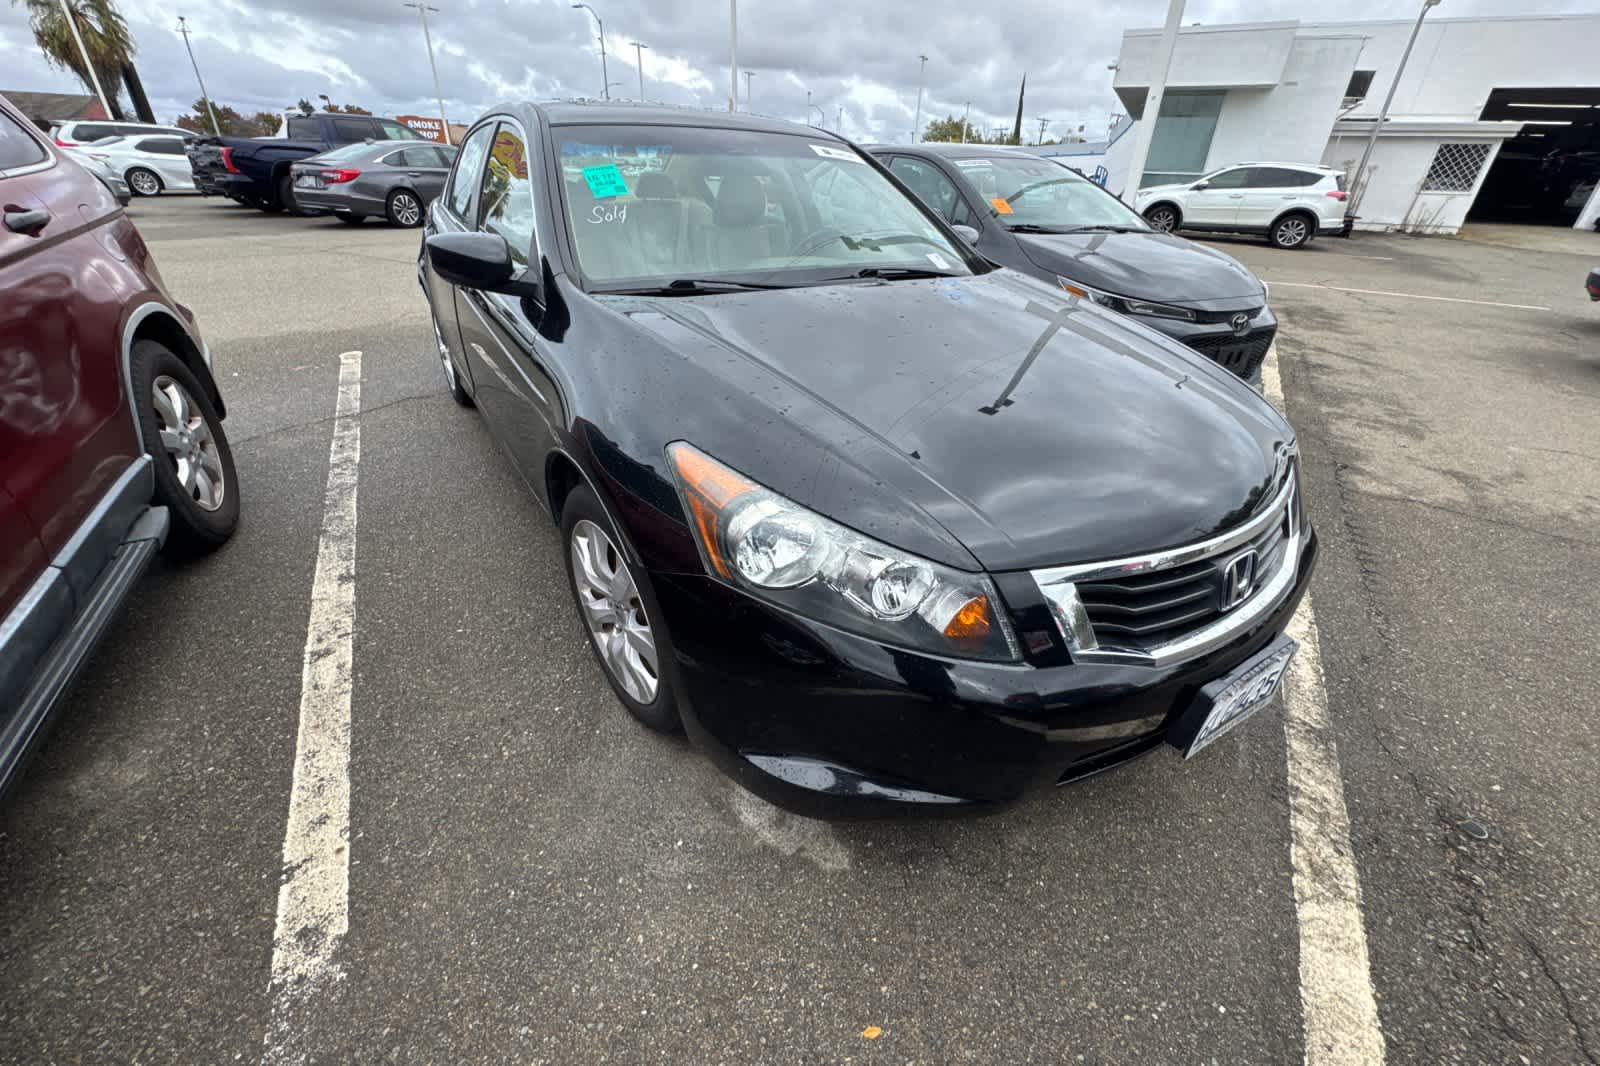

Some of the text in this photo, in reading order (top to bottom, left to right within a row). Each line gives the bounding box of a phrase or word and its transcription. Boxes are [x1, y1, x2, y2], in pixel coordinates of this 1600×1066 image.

[407, 120, 441, 129] SMOKE
[417, 130, 439, 139] HOP
[586, 205, 627, 224] Sold
